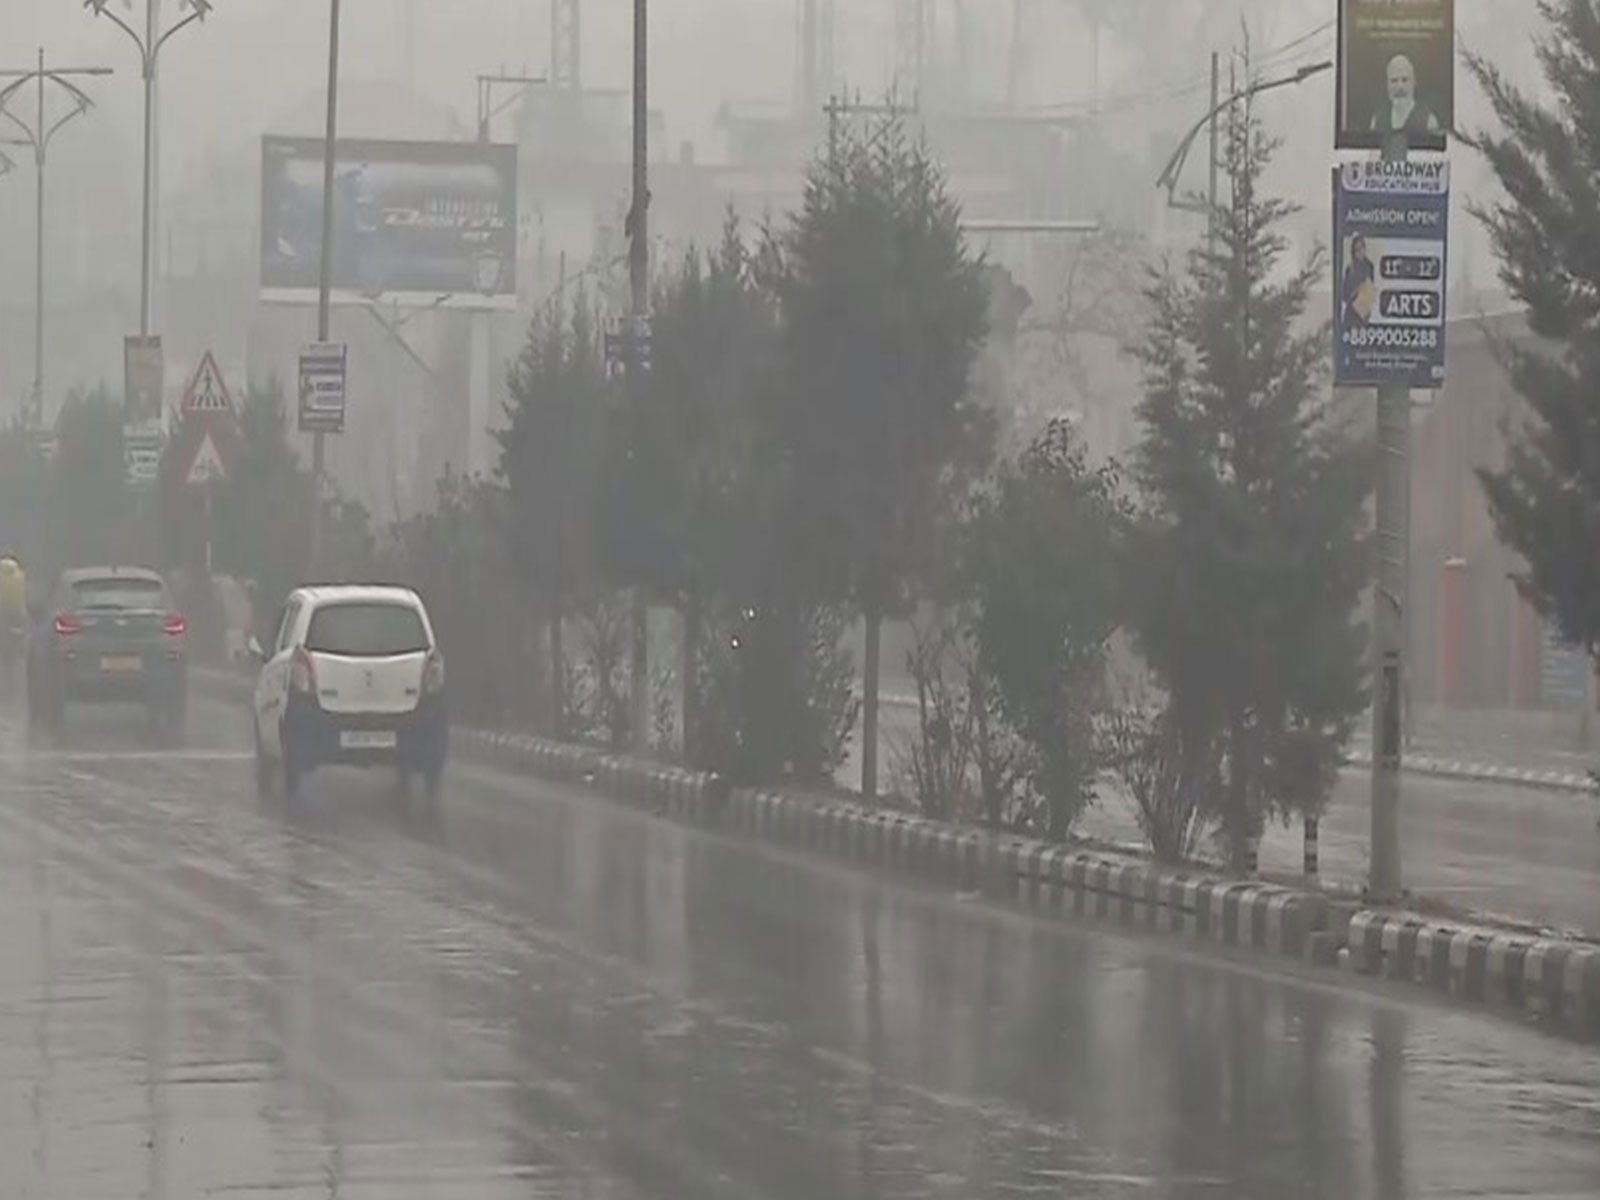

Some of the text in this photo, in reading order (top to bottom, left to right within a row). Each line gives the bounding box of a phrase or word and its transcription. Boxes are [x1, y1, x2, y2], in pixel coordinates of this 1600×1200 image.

[1365, 160, 1443, 178] BROADWAY
[1346, 208, 1439, 225] ADMISSION OPEN
[1387, 294, 1431, 316] ARTS
